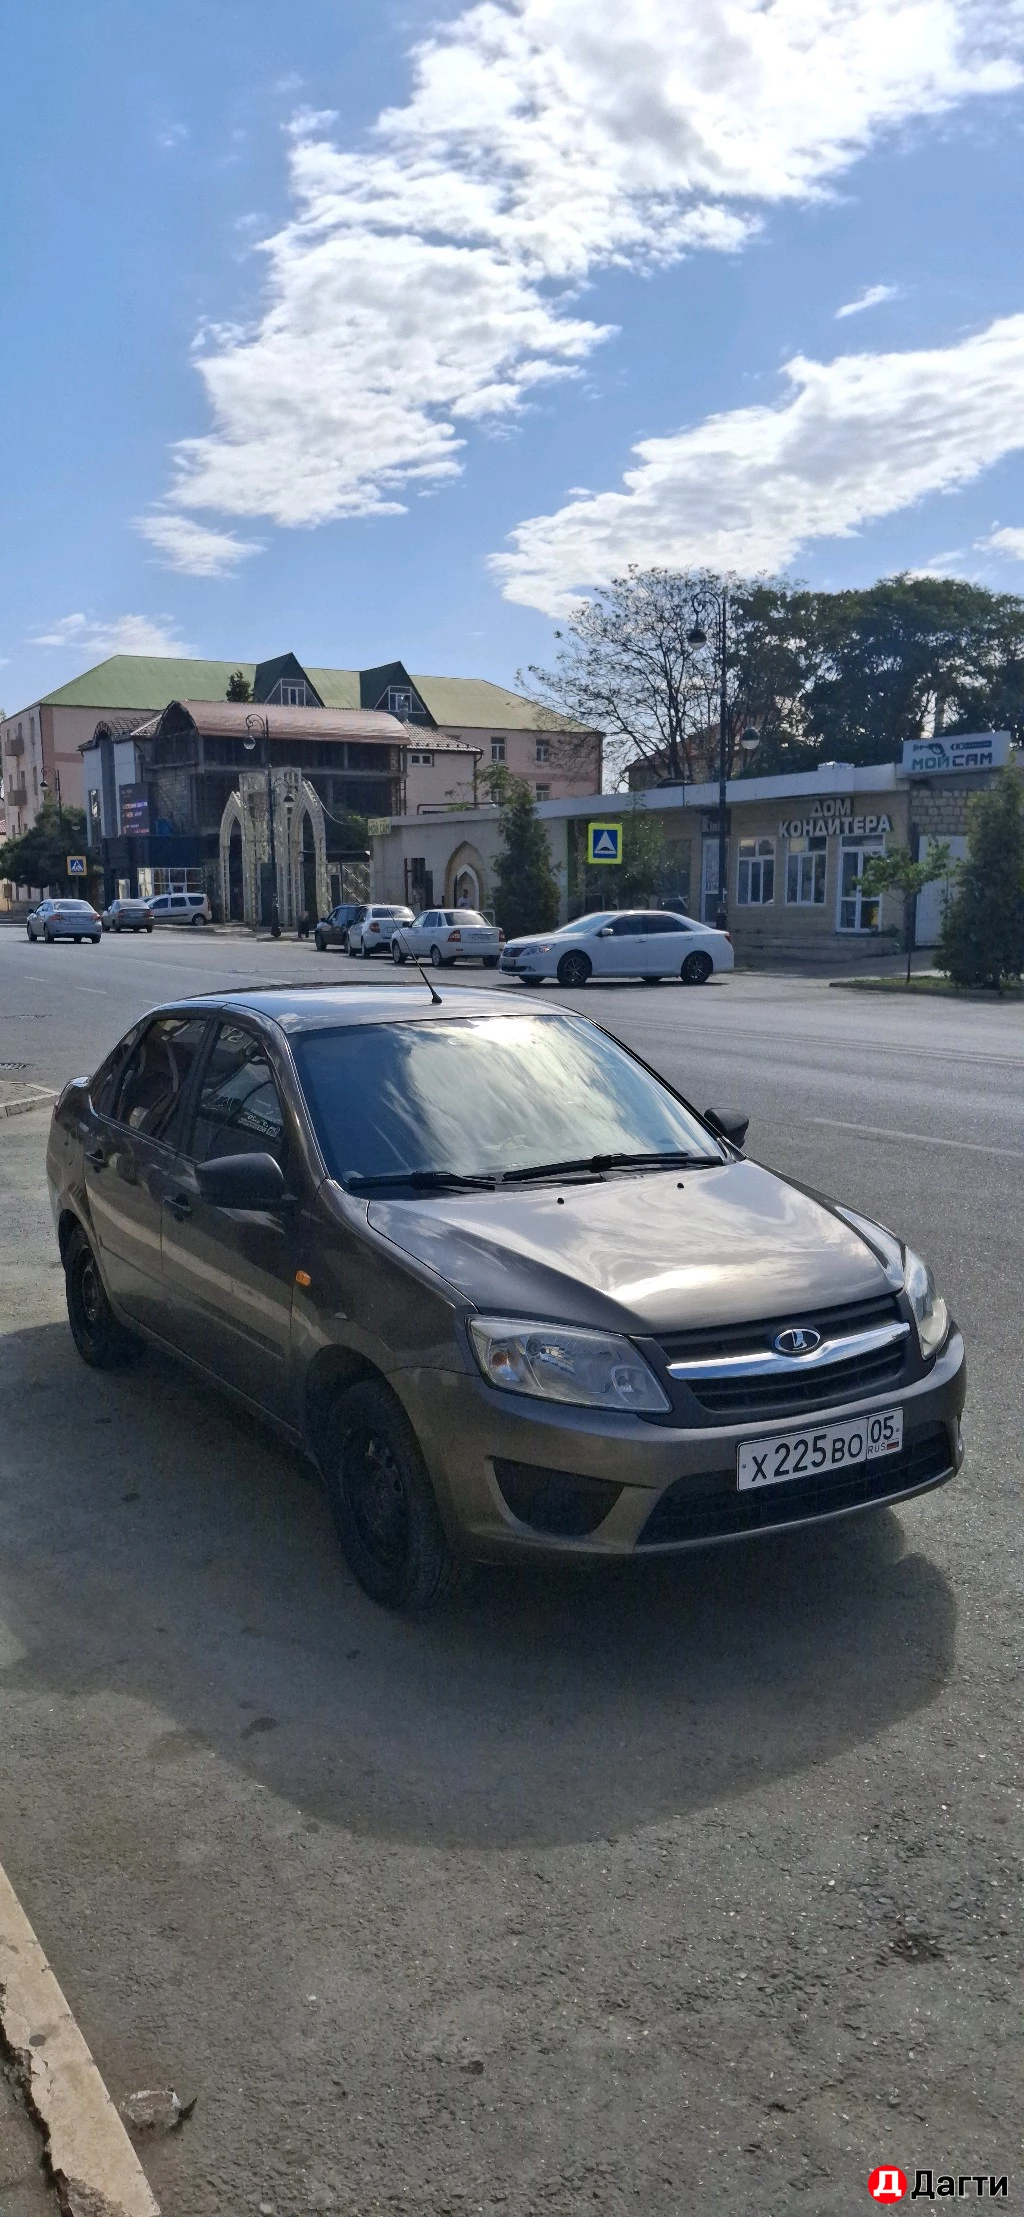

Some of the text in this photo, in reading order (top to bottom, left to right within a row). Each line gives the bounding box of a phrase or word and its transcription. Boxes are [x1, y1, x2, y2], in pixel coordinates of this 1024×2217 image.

[809, 798, 852, 817] ДОМ
[779, 814, 891, 838] КОНДИТЕРА
[870, 1415, 895, 1444] 05
[867, 1442, 886, 1455] RUS
